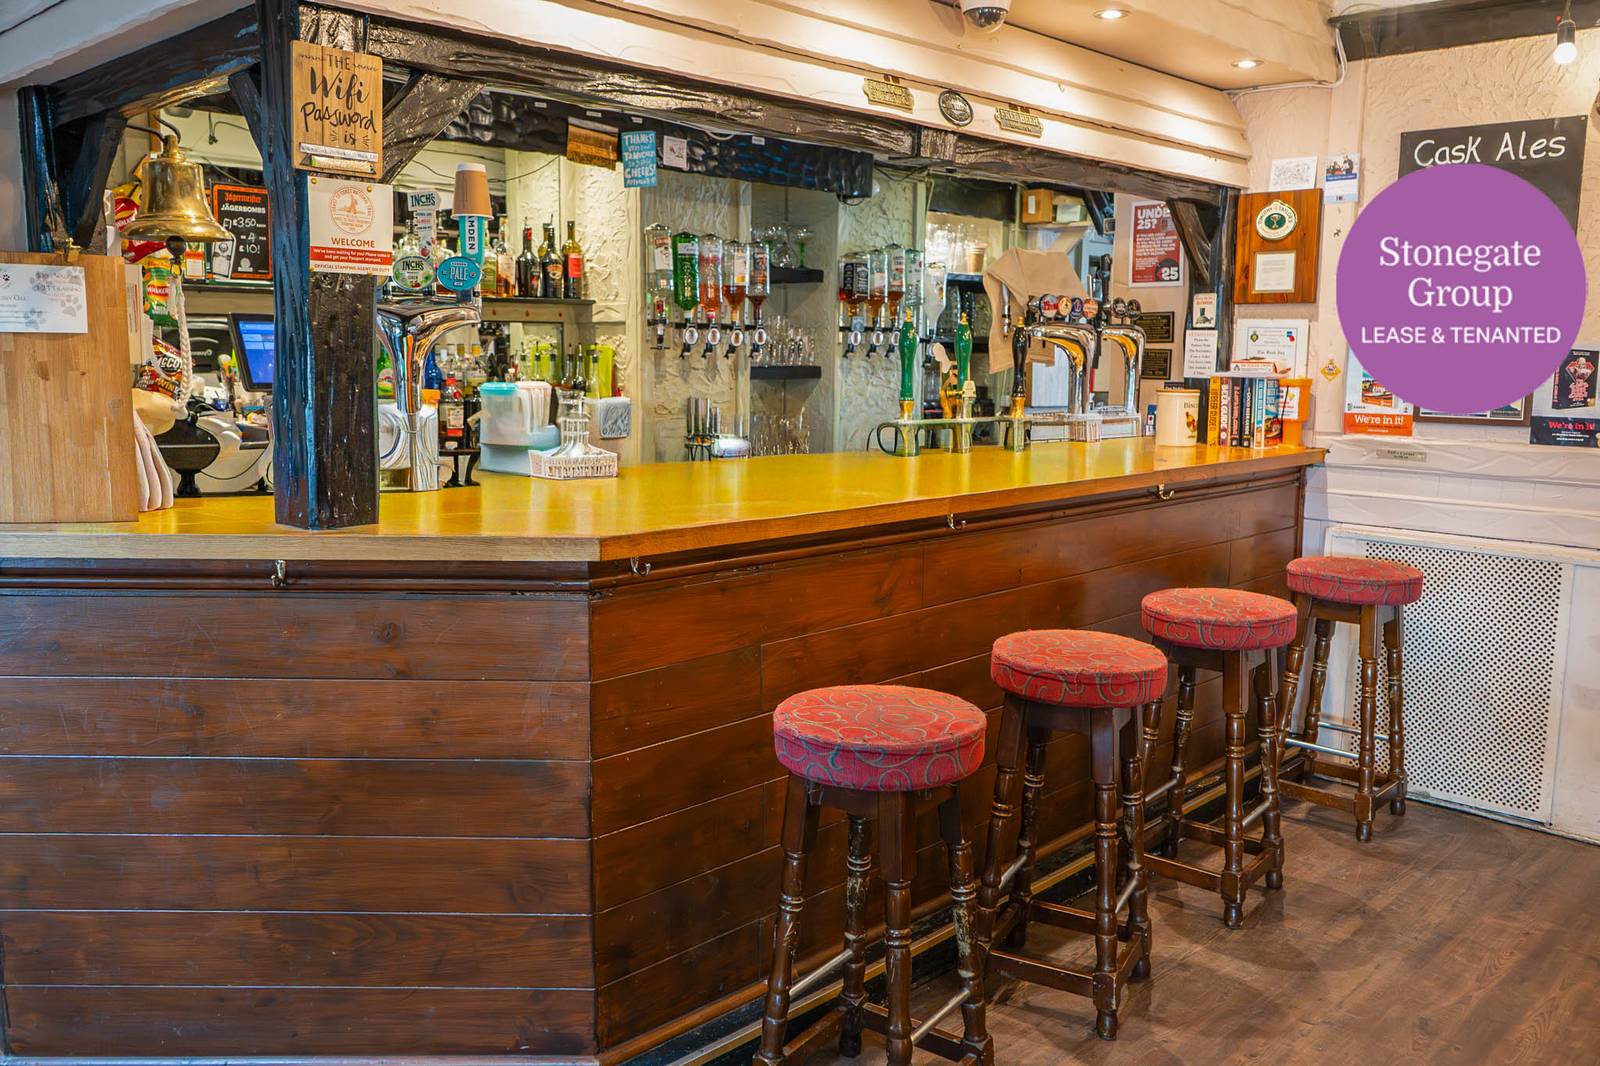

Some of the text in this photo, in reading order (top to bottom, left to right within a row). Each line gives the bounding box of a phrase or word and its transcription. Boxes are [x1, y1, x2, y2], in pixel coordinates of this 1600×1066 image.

[328, 54, 350, 70] THE
[310, 66, 370, 110] Wifi
[300, 102, 377, 133] Password
[344, 130, 356, 145] is
[1496, 130, 1567, 161] Ales
[1138, 208, 1170, 219] UNDE
[1137, 218, 1157, 230] 25?
[331, 237, 376, 248] WELCOME
[450, 267, 468, 280] PALE
[1162, 266, 1178, 280] 25
[147, 286, 169, 295] WALKER
[1354, 414, 1404, 425] We're in it!
[1548, 421, 1572, 430] We're
[1575, 422, 1584, 430] in
